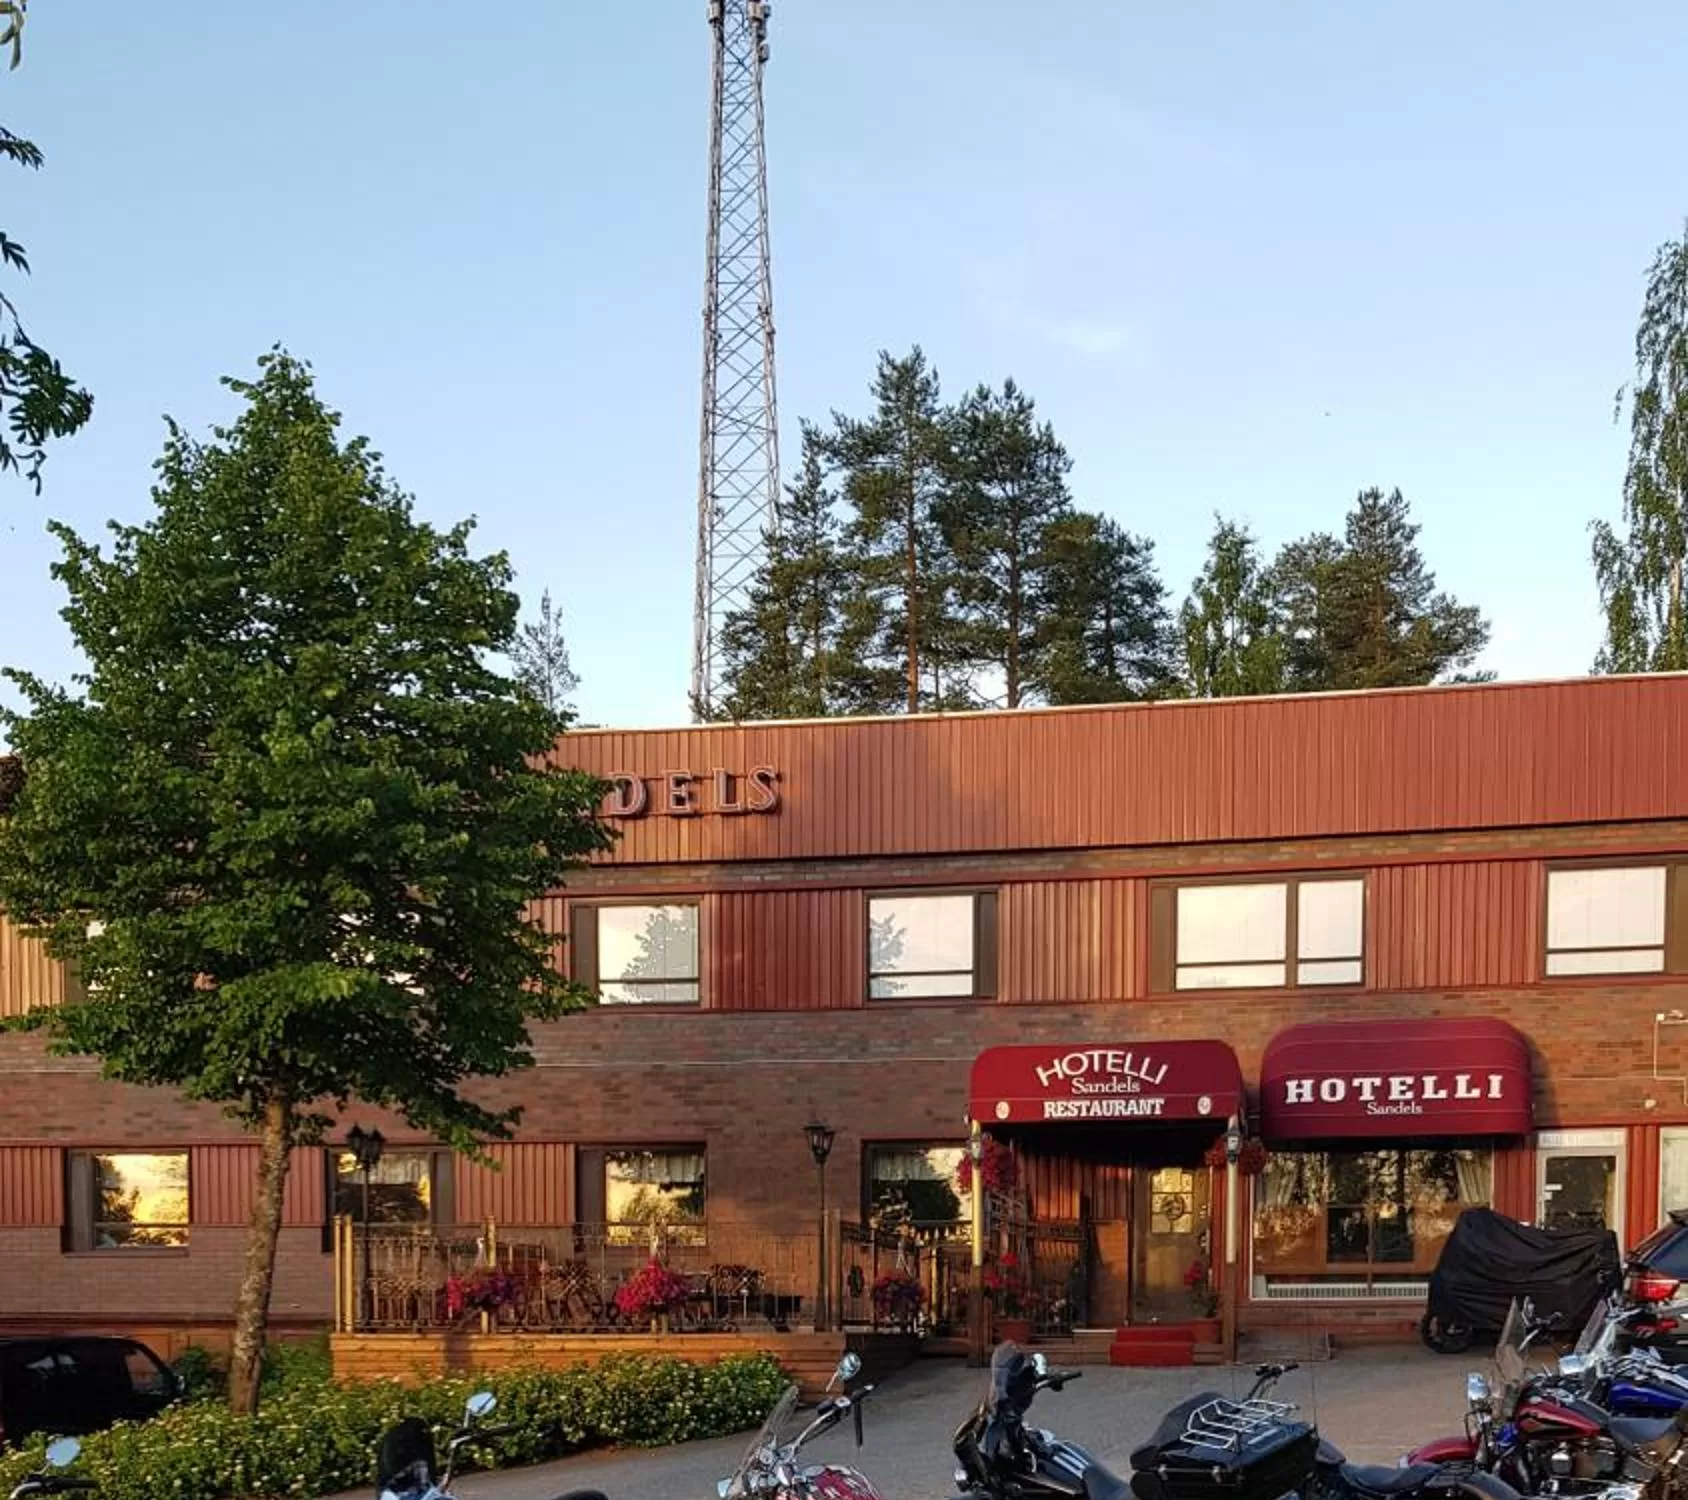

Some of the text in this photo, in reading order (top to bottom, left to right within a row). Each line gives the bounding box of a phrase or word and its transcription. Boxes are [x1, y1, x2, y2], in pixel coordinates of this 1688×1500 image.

[1035, 1049, 1168, 1087] HOTELLI
[1071, 1076, 1140, 1095] Sandels
[1284, 1074, 1504, 1104] HOTELLI
[1043, 1098, 1165, 1119] RESTAURANT
[1366, 1101, 1423, 1115] Sandels
